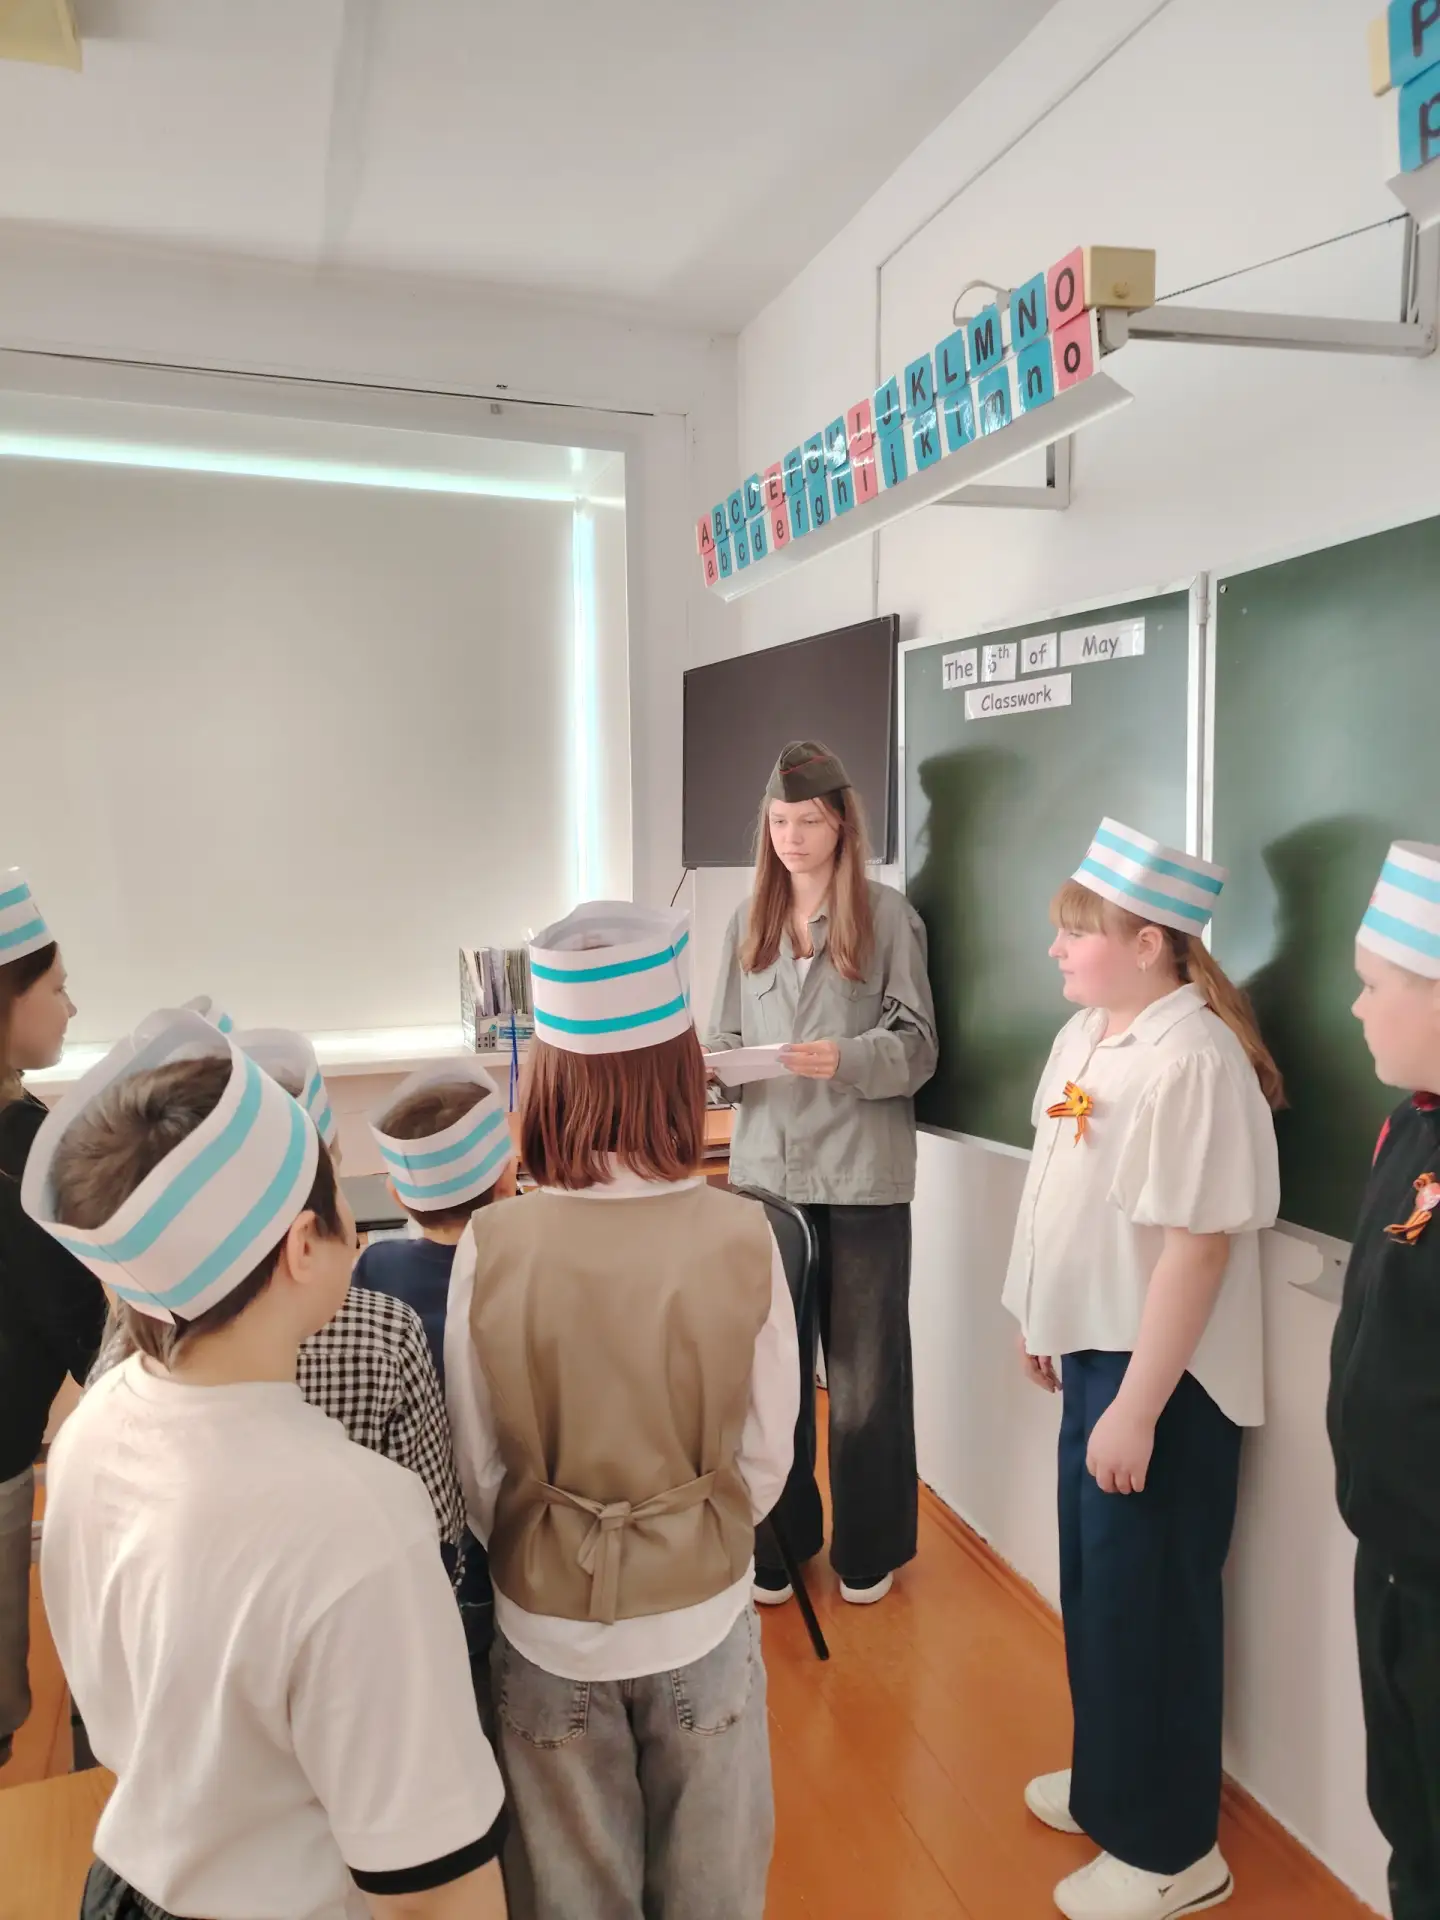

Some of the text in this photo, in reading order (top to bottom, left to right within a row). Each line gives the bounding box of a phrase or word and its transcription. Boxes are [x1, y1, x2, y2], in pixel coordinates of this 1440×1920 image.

[1411, 0, 1440, 57] P
[702, 523, 710, 547] A
[715, 510, 722, 536] B
[731, 498, 740, 524] C
[747, 484, 757, 510] D
[769, 472, 778, 500] E
[912, 367, 926, 406] K
[944, 349, 957, 383] L
[974, 318, 994, 365] M
[1018, 288, 1037, 338] N
[1055, 267, 1075, 312] O
[707, 560, 714, 579] a
[721, 548, 728, 572] b
[738, 542, 745, 561] c
[755, 525, 763, 552] d
[776, 519, 784, 539] e
[796, 500, 802, 528] f
[815, 494, 825, 525] g
[837, 474, 848, 505] h
[890, 443, 898, 485] j
[1027, 365, 1043, 399] n
[1064, 341, 1081, 373] o
[945, 660, 973, 681] The
[1029, 642, 1048, 665] of
[1082, 635, 1119, 658] May
[981, 685, 1052, 711] Classwork
